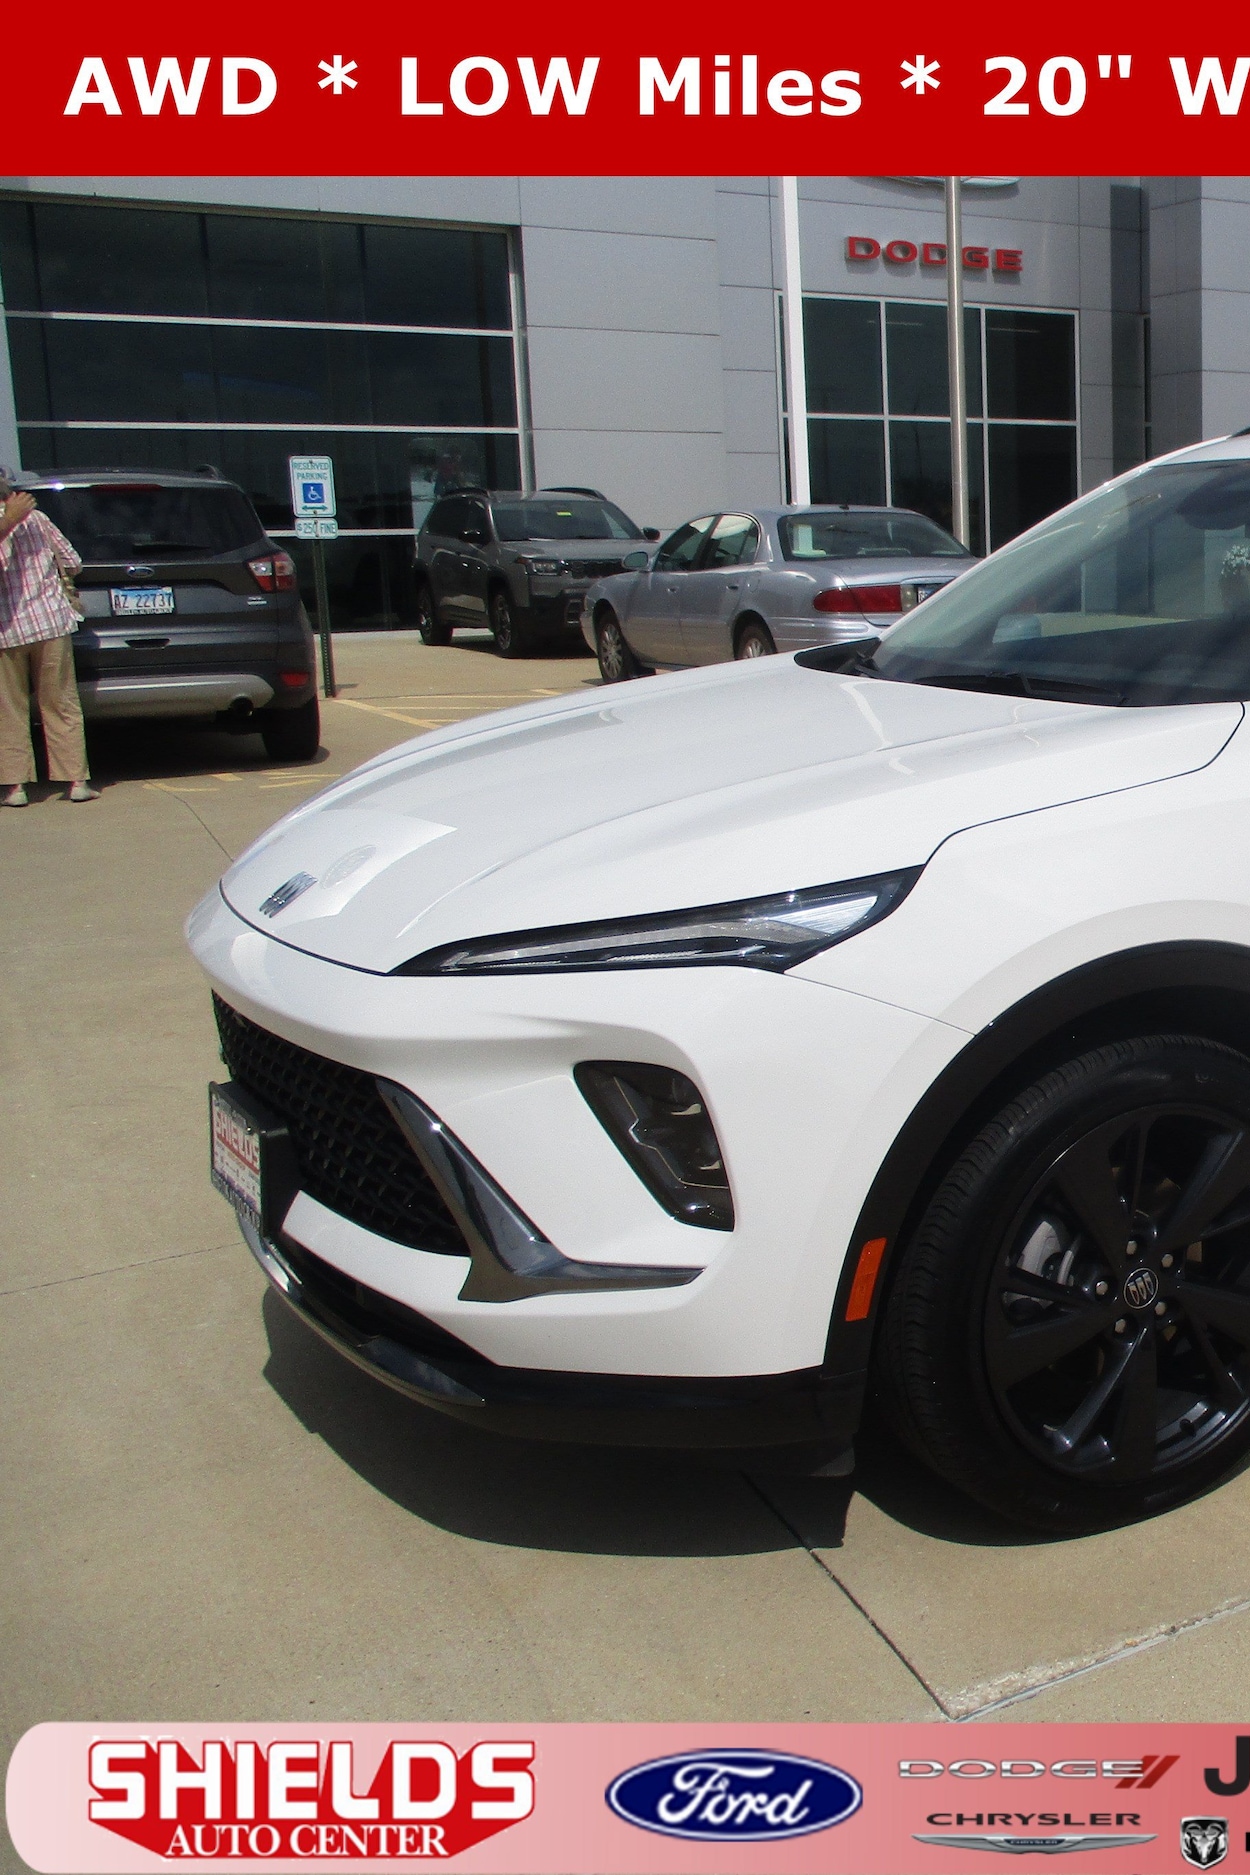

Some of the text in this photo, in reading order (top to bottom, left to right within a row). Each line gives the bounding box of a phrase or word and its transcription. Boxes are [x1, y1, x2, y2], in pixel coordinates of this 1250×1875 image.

[847, 236, 1023, 272] DODGE
[292, 462, 329, 471] RESERVED
[296, 472, 328, 480] PARKING
[320, 523, 337, 534] FINE
[114, 594, 130, 609] AZ
